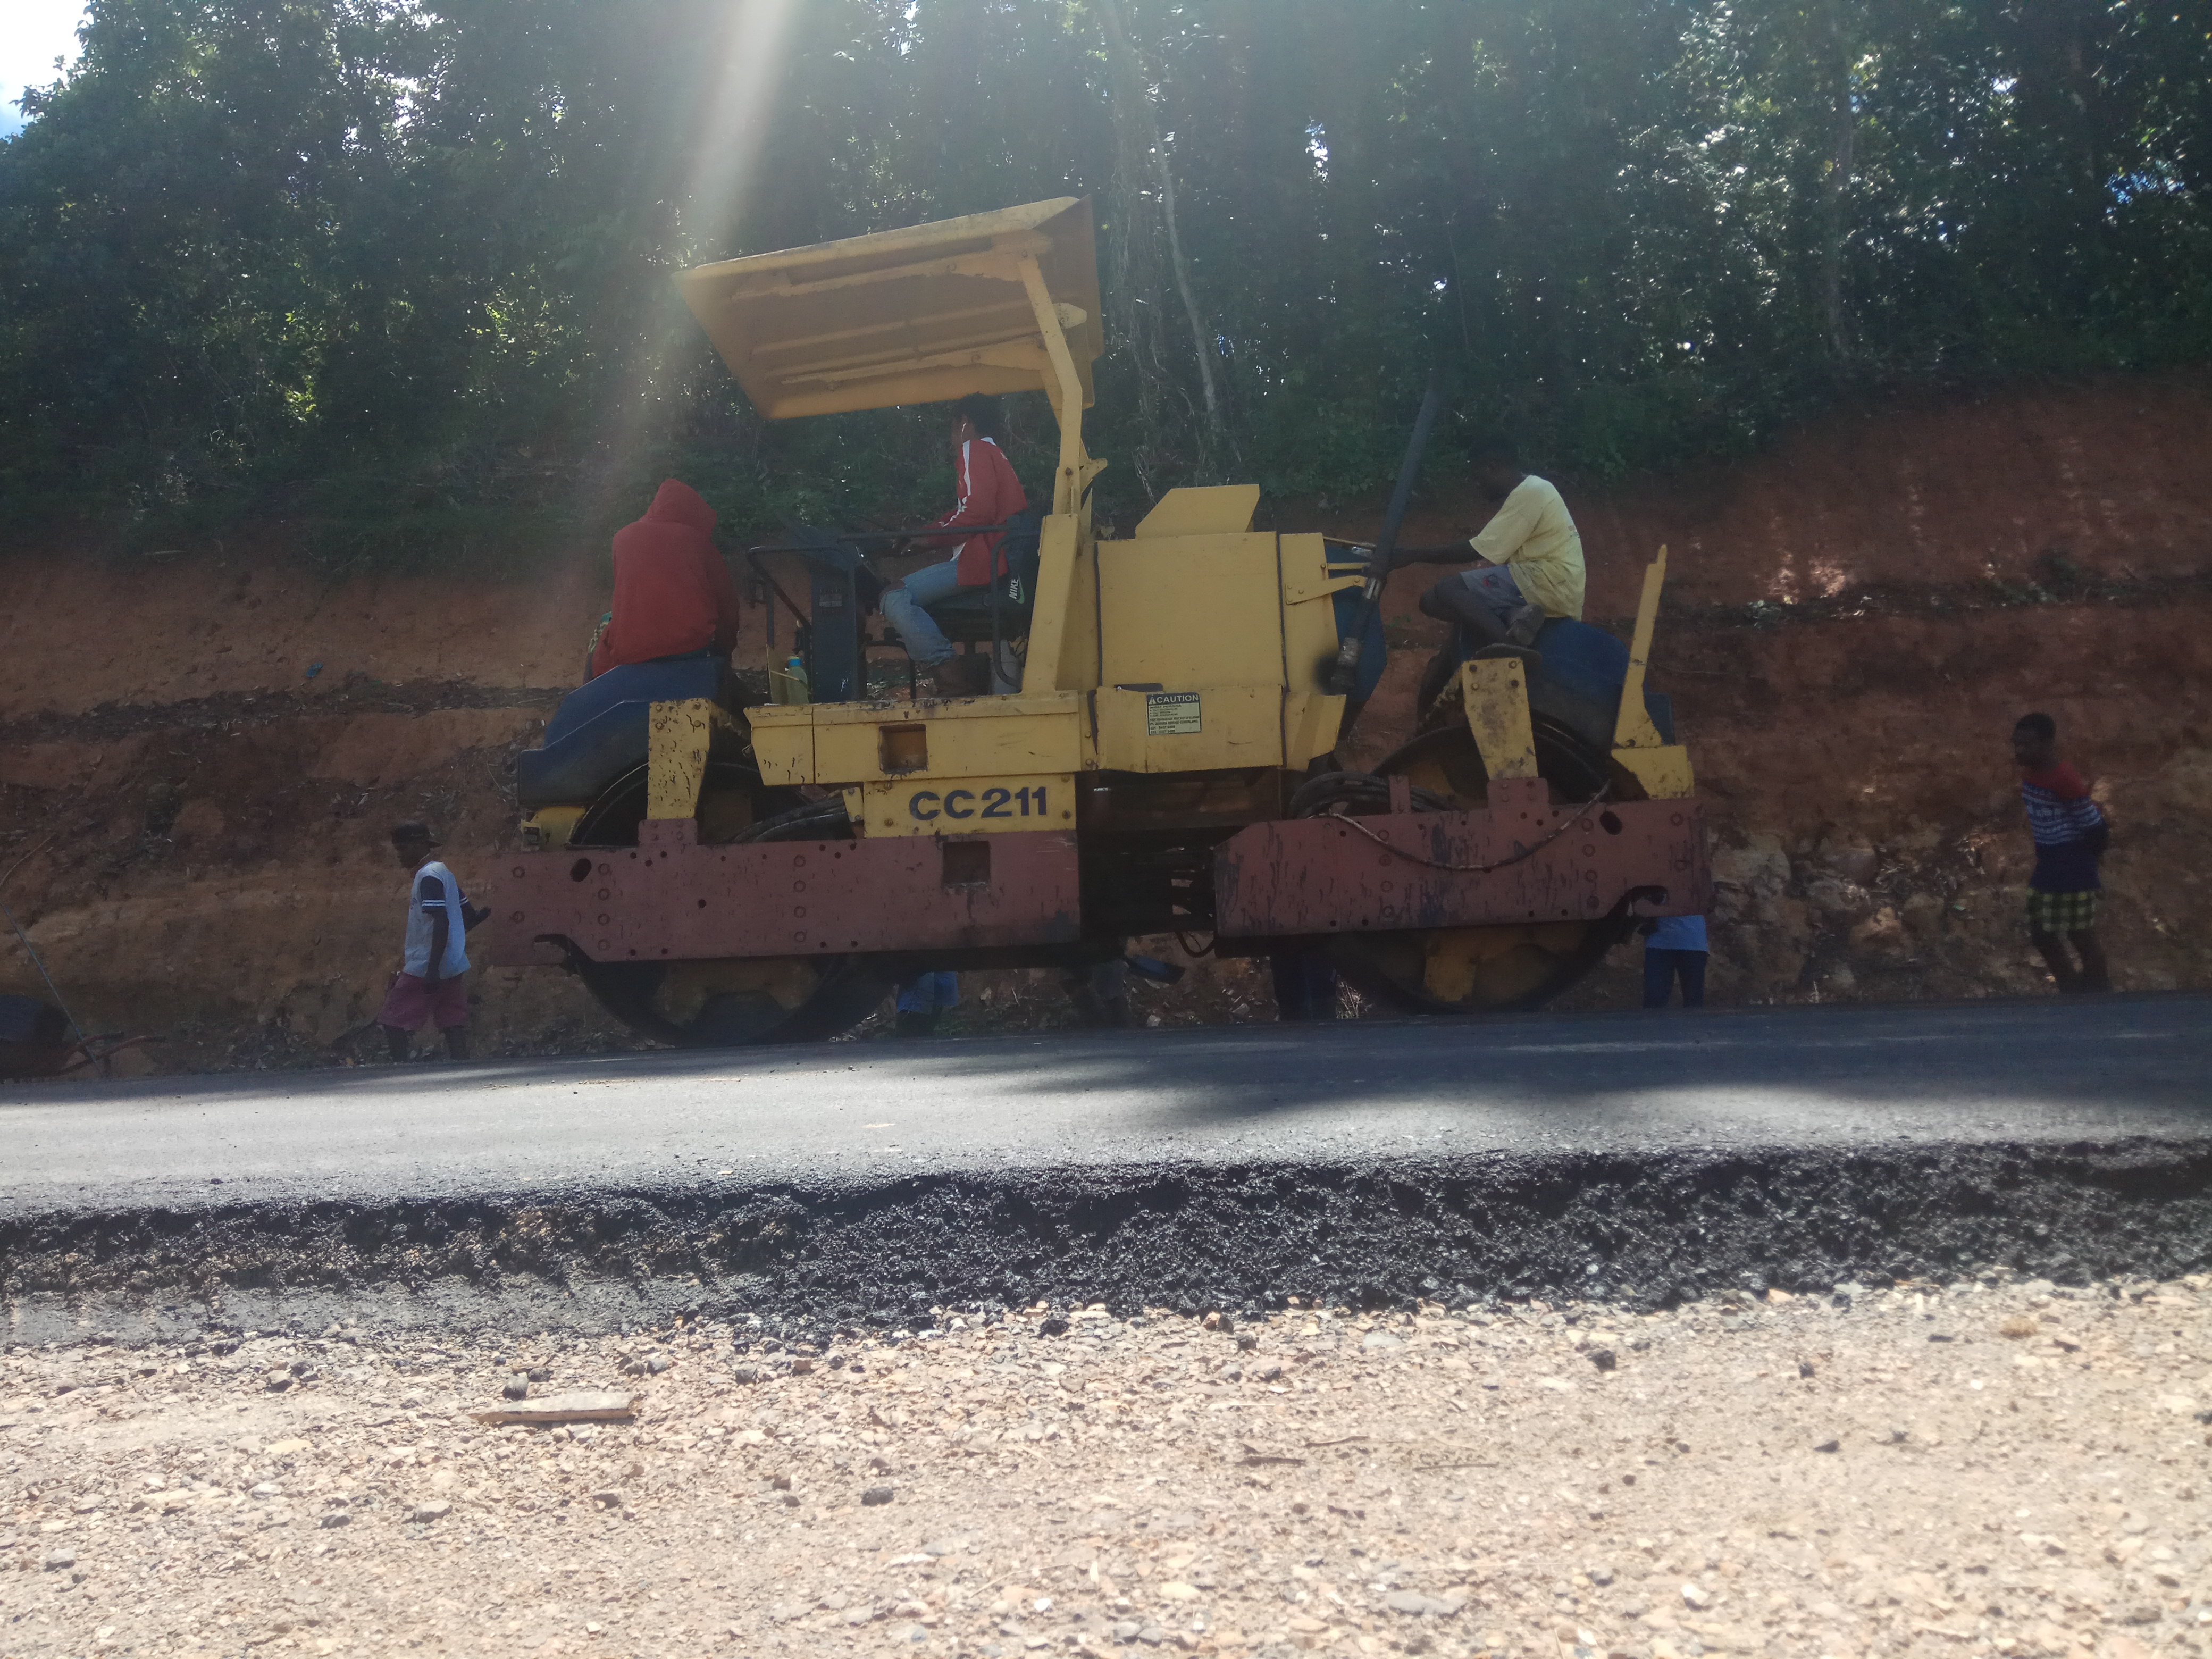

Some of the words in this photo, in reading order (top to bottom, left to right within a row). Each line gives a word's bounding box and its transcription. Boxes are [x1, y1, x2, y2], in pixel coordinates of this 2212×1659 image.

[1009, 579, 1019, 599] NIKE
[1157, 694, 1199, 703] CAUTION
[909, 786, 1047, 820] CC211
